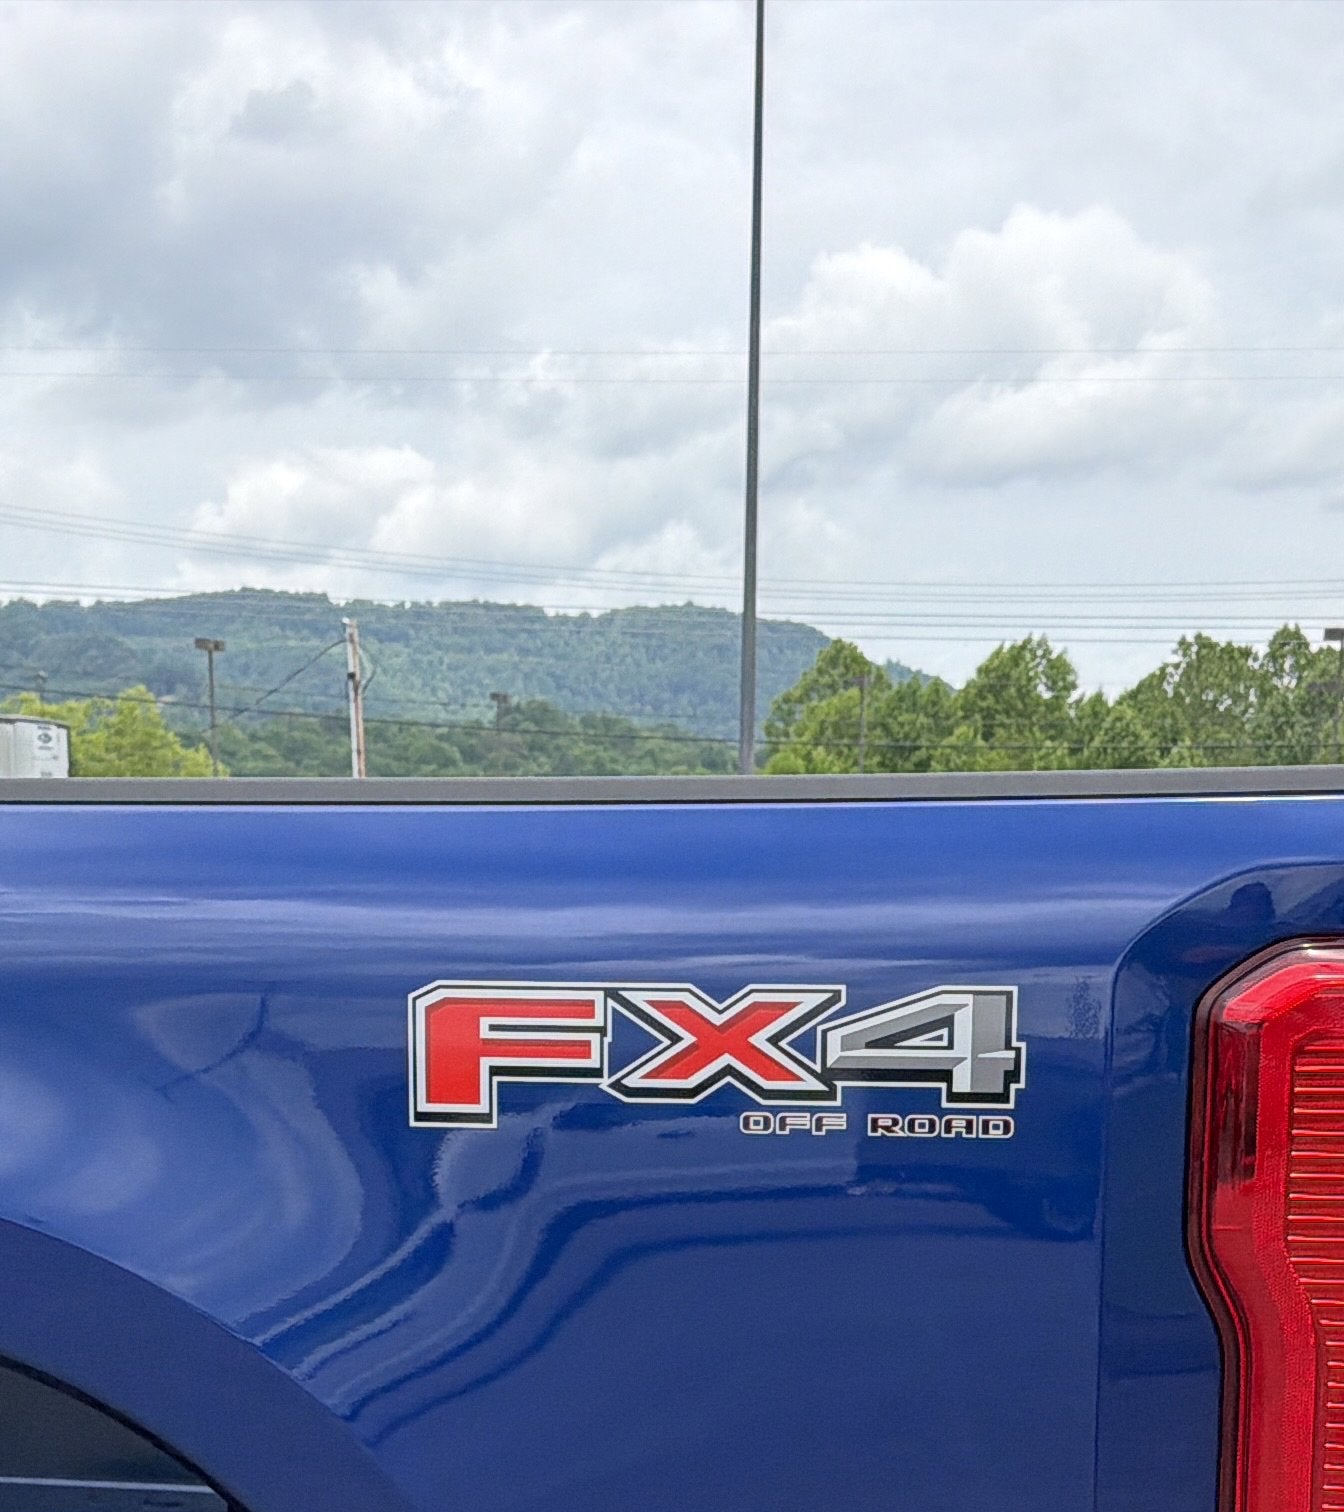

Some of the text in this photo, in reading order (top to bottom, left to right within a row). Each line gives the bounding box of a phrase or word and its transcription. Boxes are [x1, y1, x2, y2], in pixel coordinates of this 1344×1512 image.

[408, 979, 1026, 1128] FX4
[739, 1111, 1015, 1139] OFF ROAD
